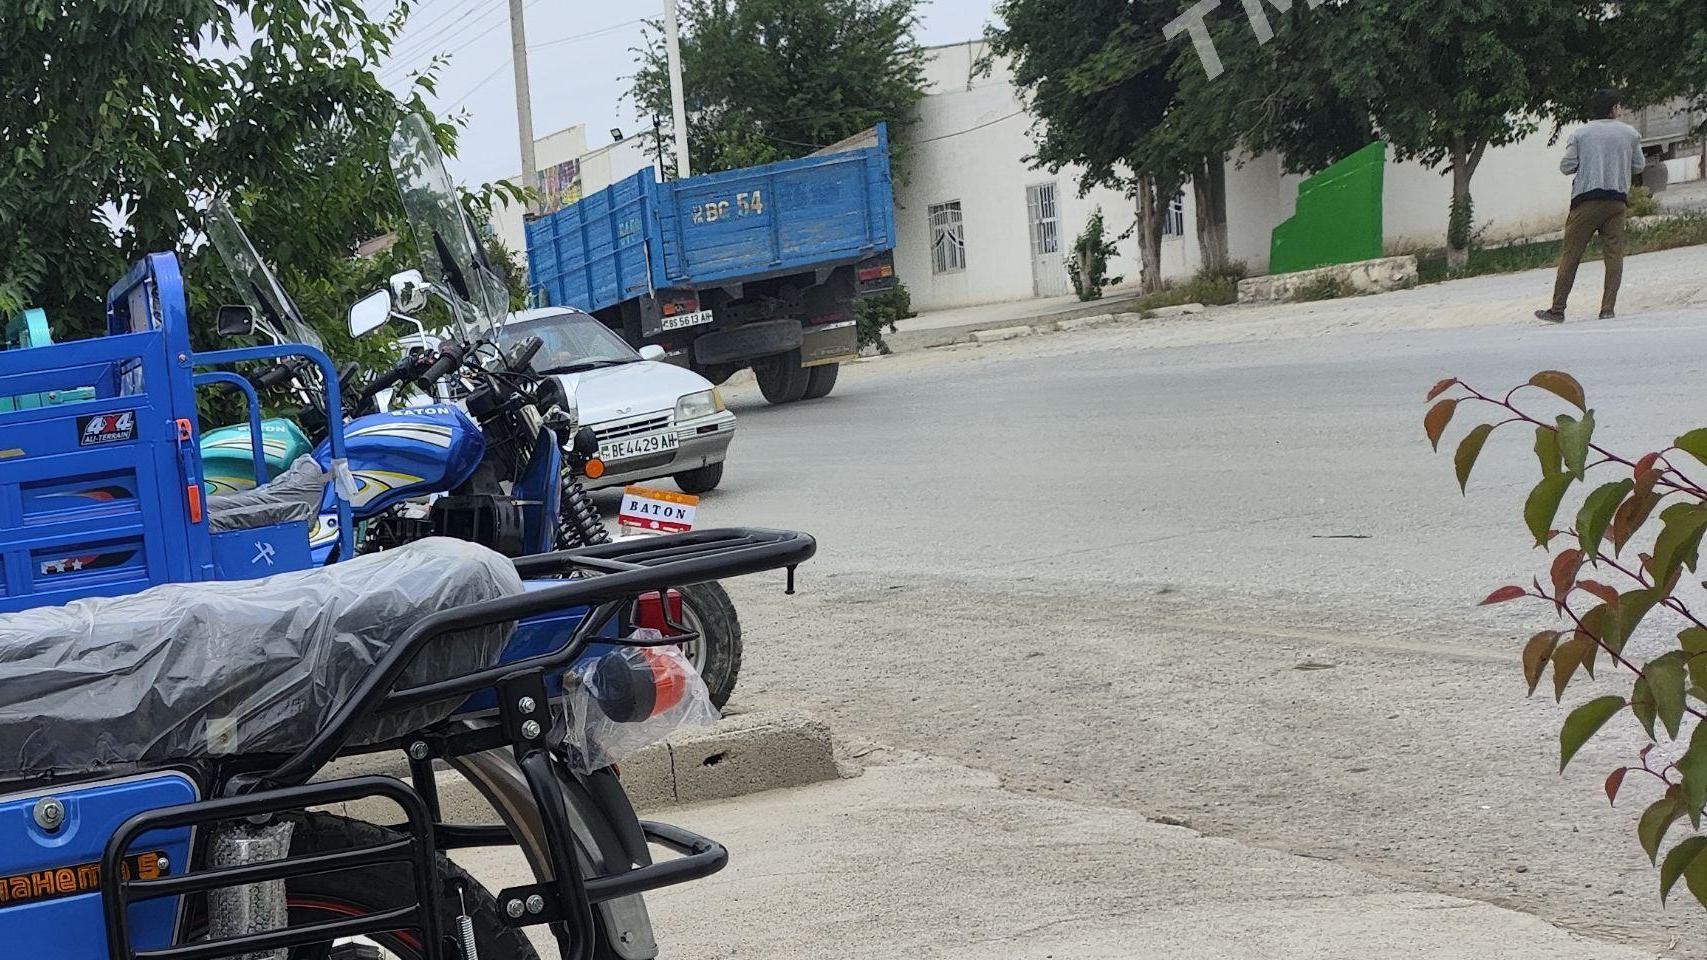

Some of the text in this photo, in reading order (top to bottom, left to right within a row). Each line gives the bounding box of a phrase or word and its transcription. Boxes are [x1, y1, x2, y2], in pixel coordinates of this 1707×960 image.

[736, 190, 764, 216] 54
[629, 501, 686, 520] BATON
[137, 853, 160, 880] 5
